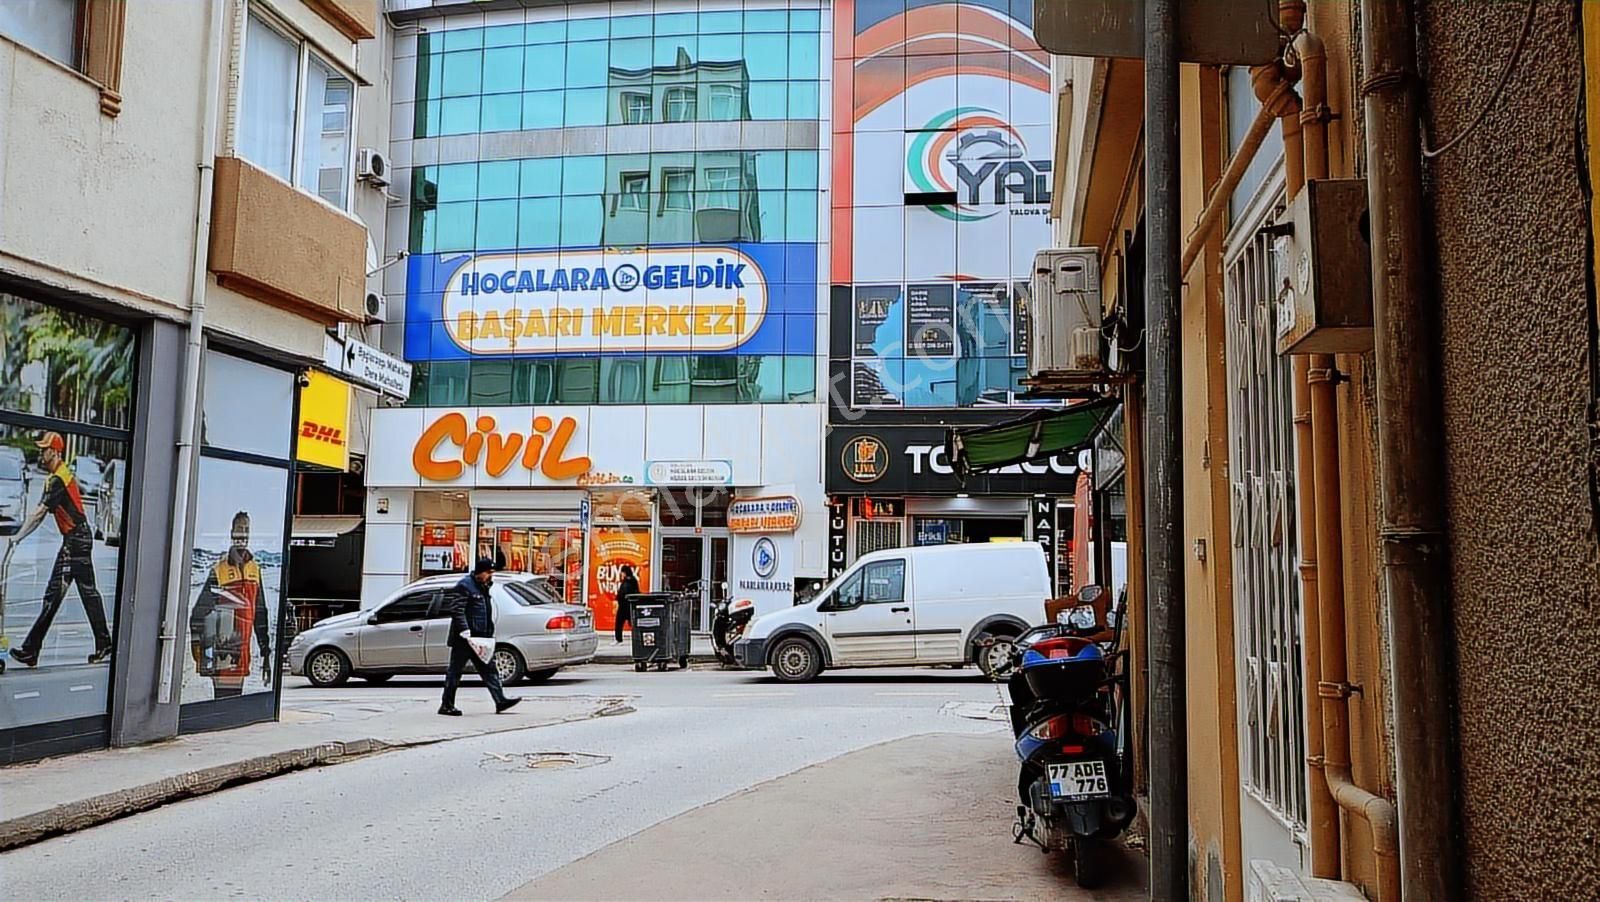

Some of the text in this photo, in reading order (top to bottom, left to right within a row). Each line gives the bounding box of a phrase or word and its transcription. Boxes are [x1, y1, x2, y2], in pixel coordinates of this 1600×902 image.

[461, 258, 747, 295] HOCALARA GELDİK
[456, 297, 747, 348] BAŞARI MERKEZİ
[301, 421, 343, 447] DHL
[597, 562, 640, 582] BÜYK
[1049, 762, 1103, 779] 77 ADE
[1075, 778, 1106, 792] 776
